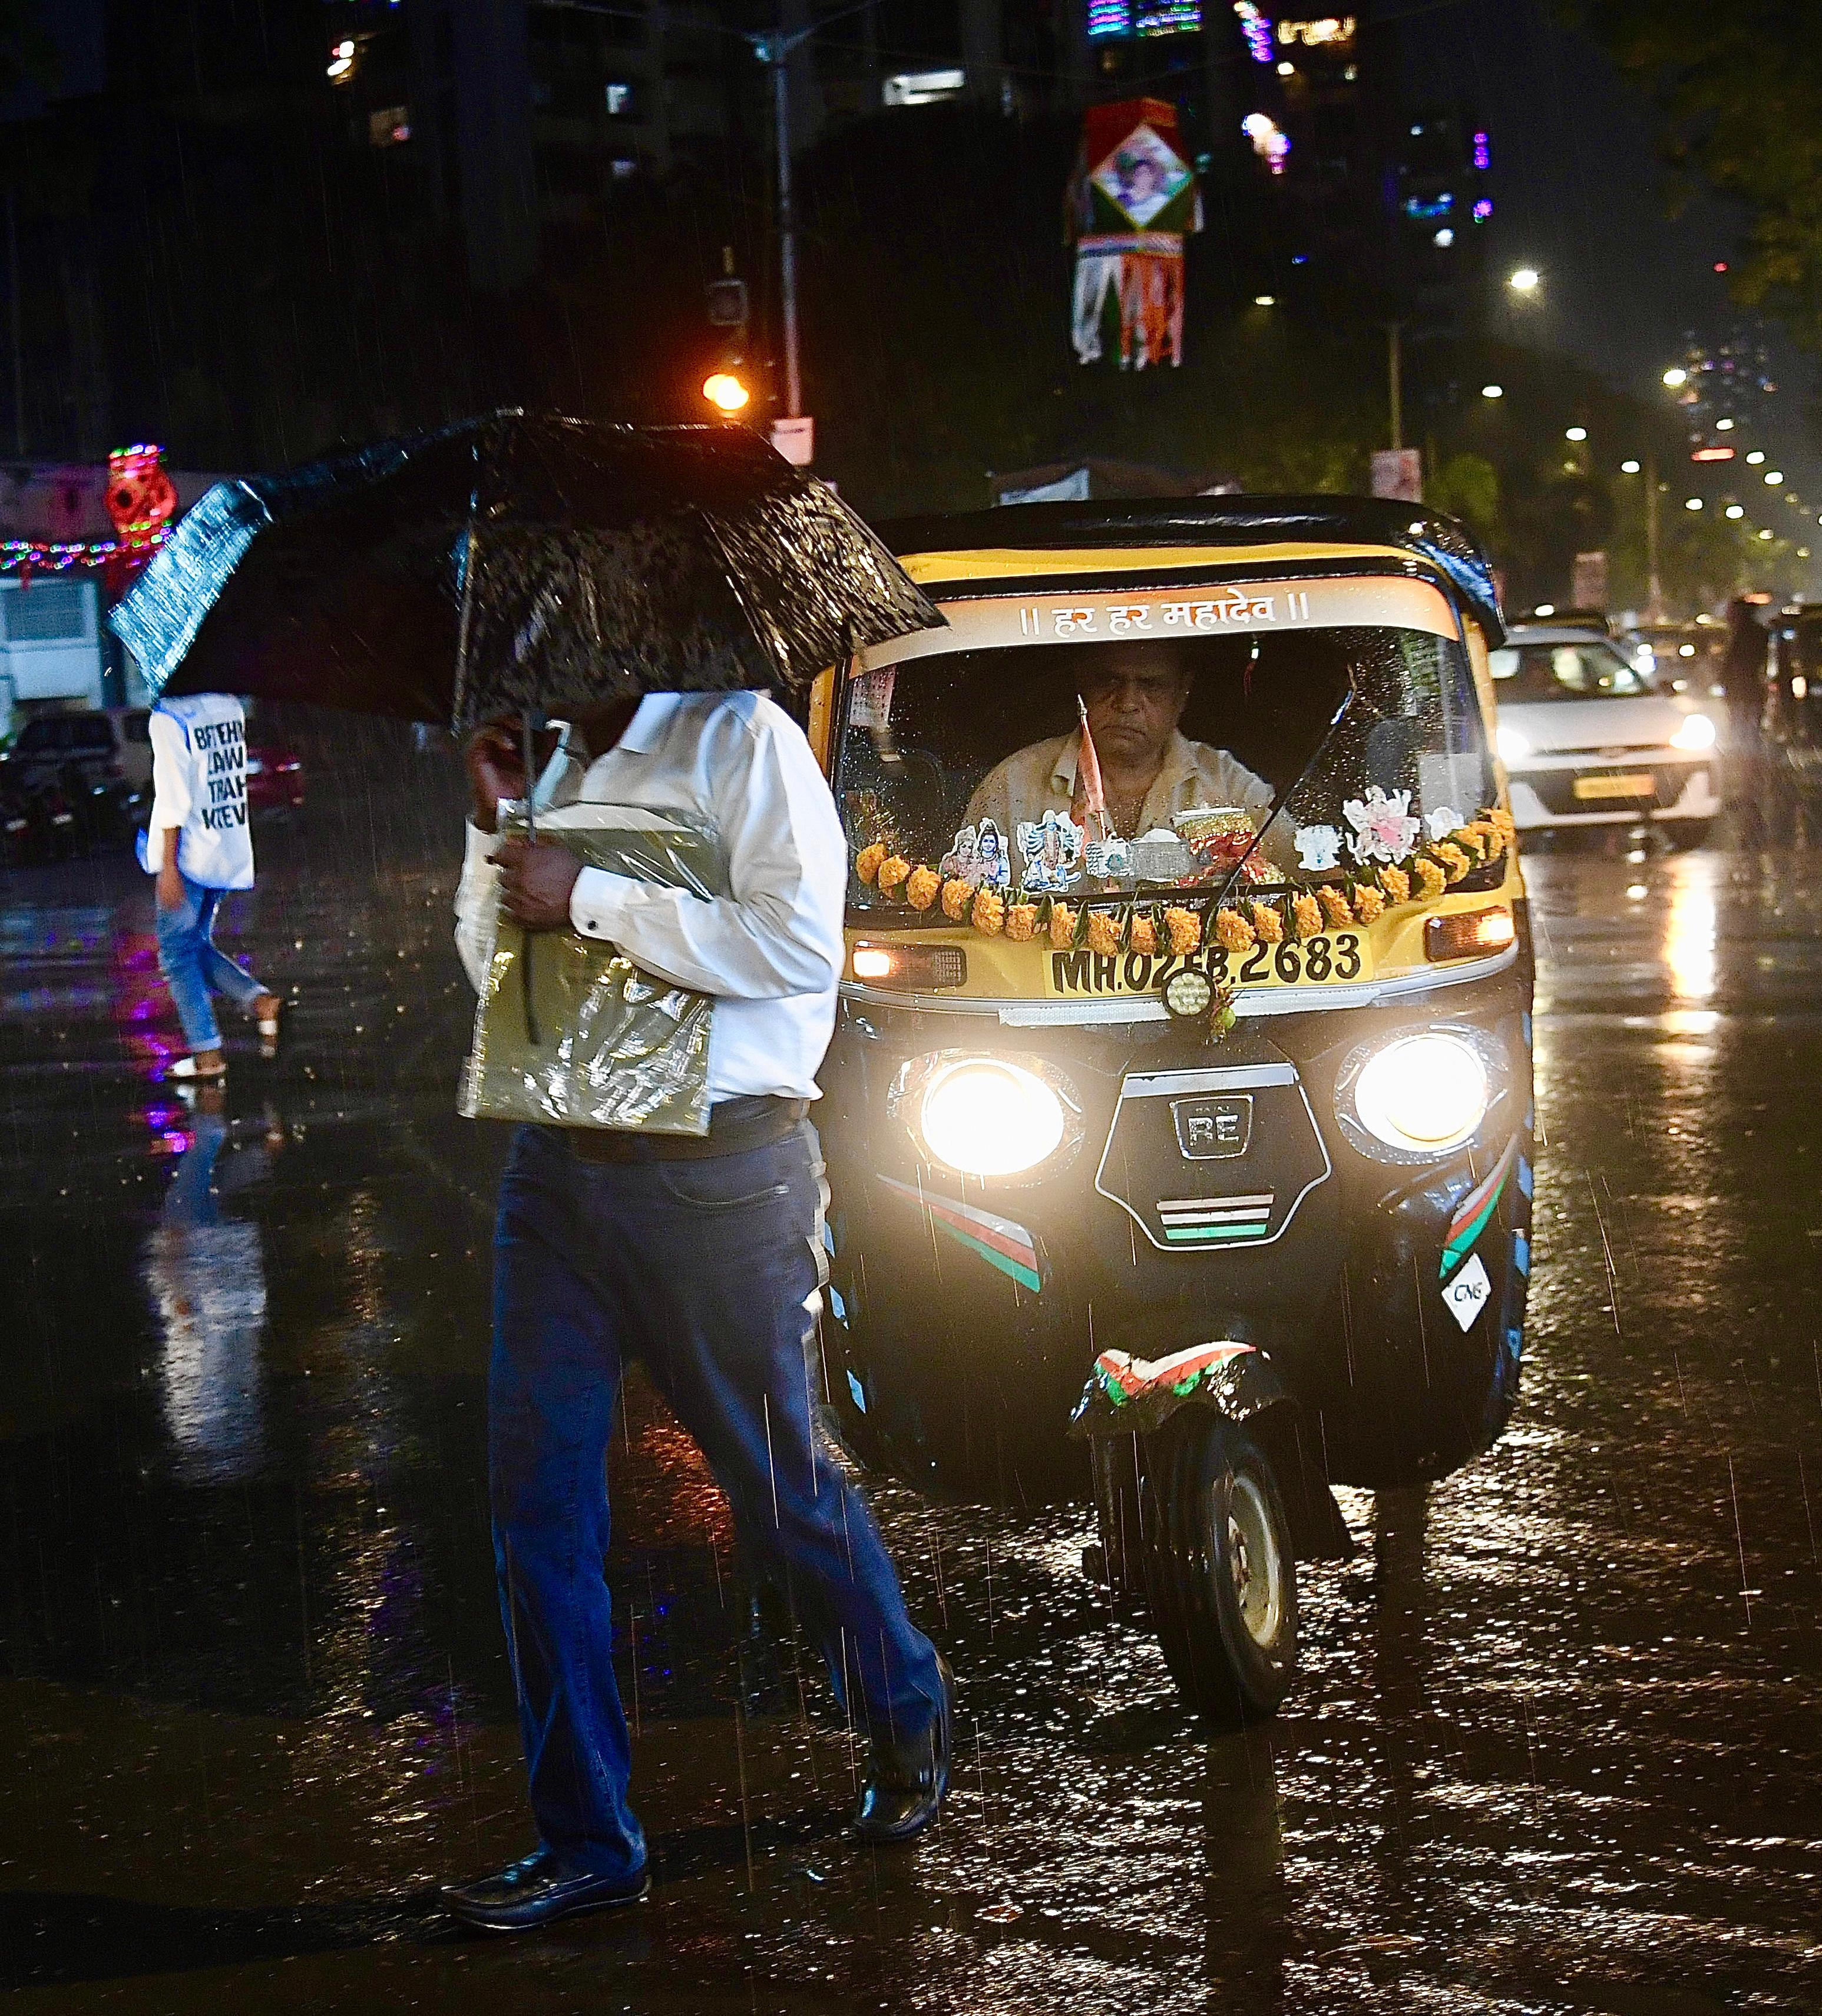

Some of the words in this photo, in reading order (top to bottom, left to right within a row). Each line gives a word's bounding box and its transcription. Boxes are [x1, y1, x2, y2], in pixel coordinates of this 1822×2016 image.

[1051, 607, 1097, 637] हर
[1106, 604, 1152, 636] हर
[1160, 588, 1276, 630] महादेव
[1188, 1114, 1240, 1145] RE
